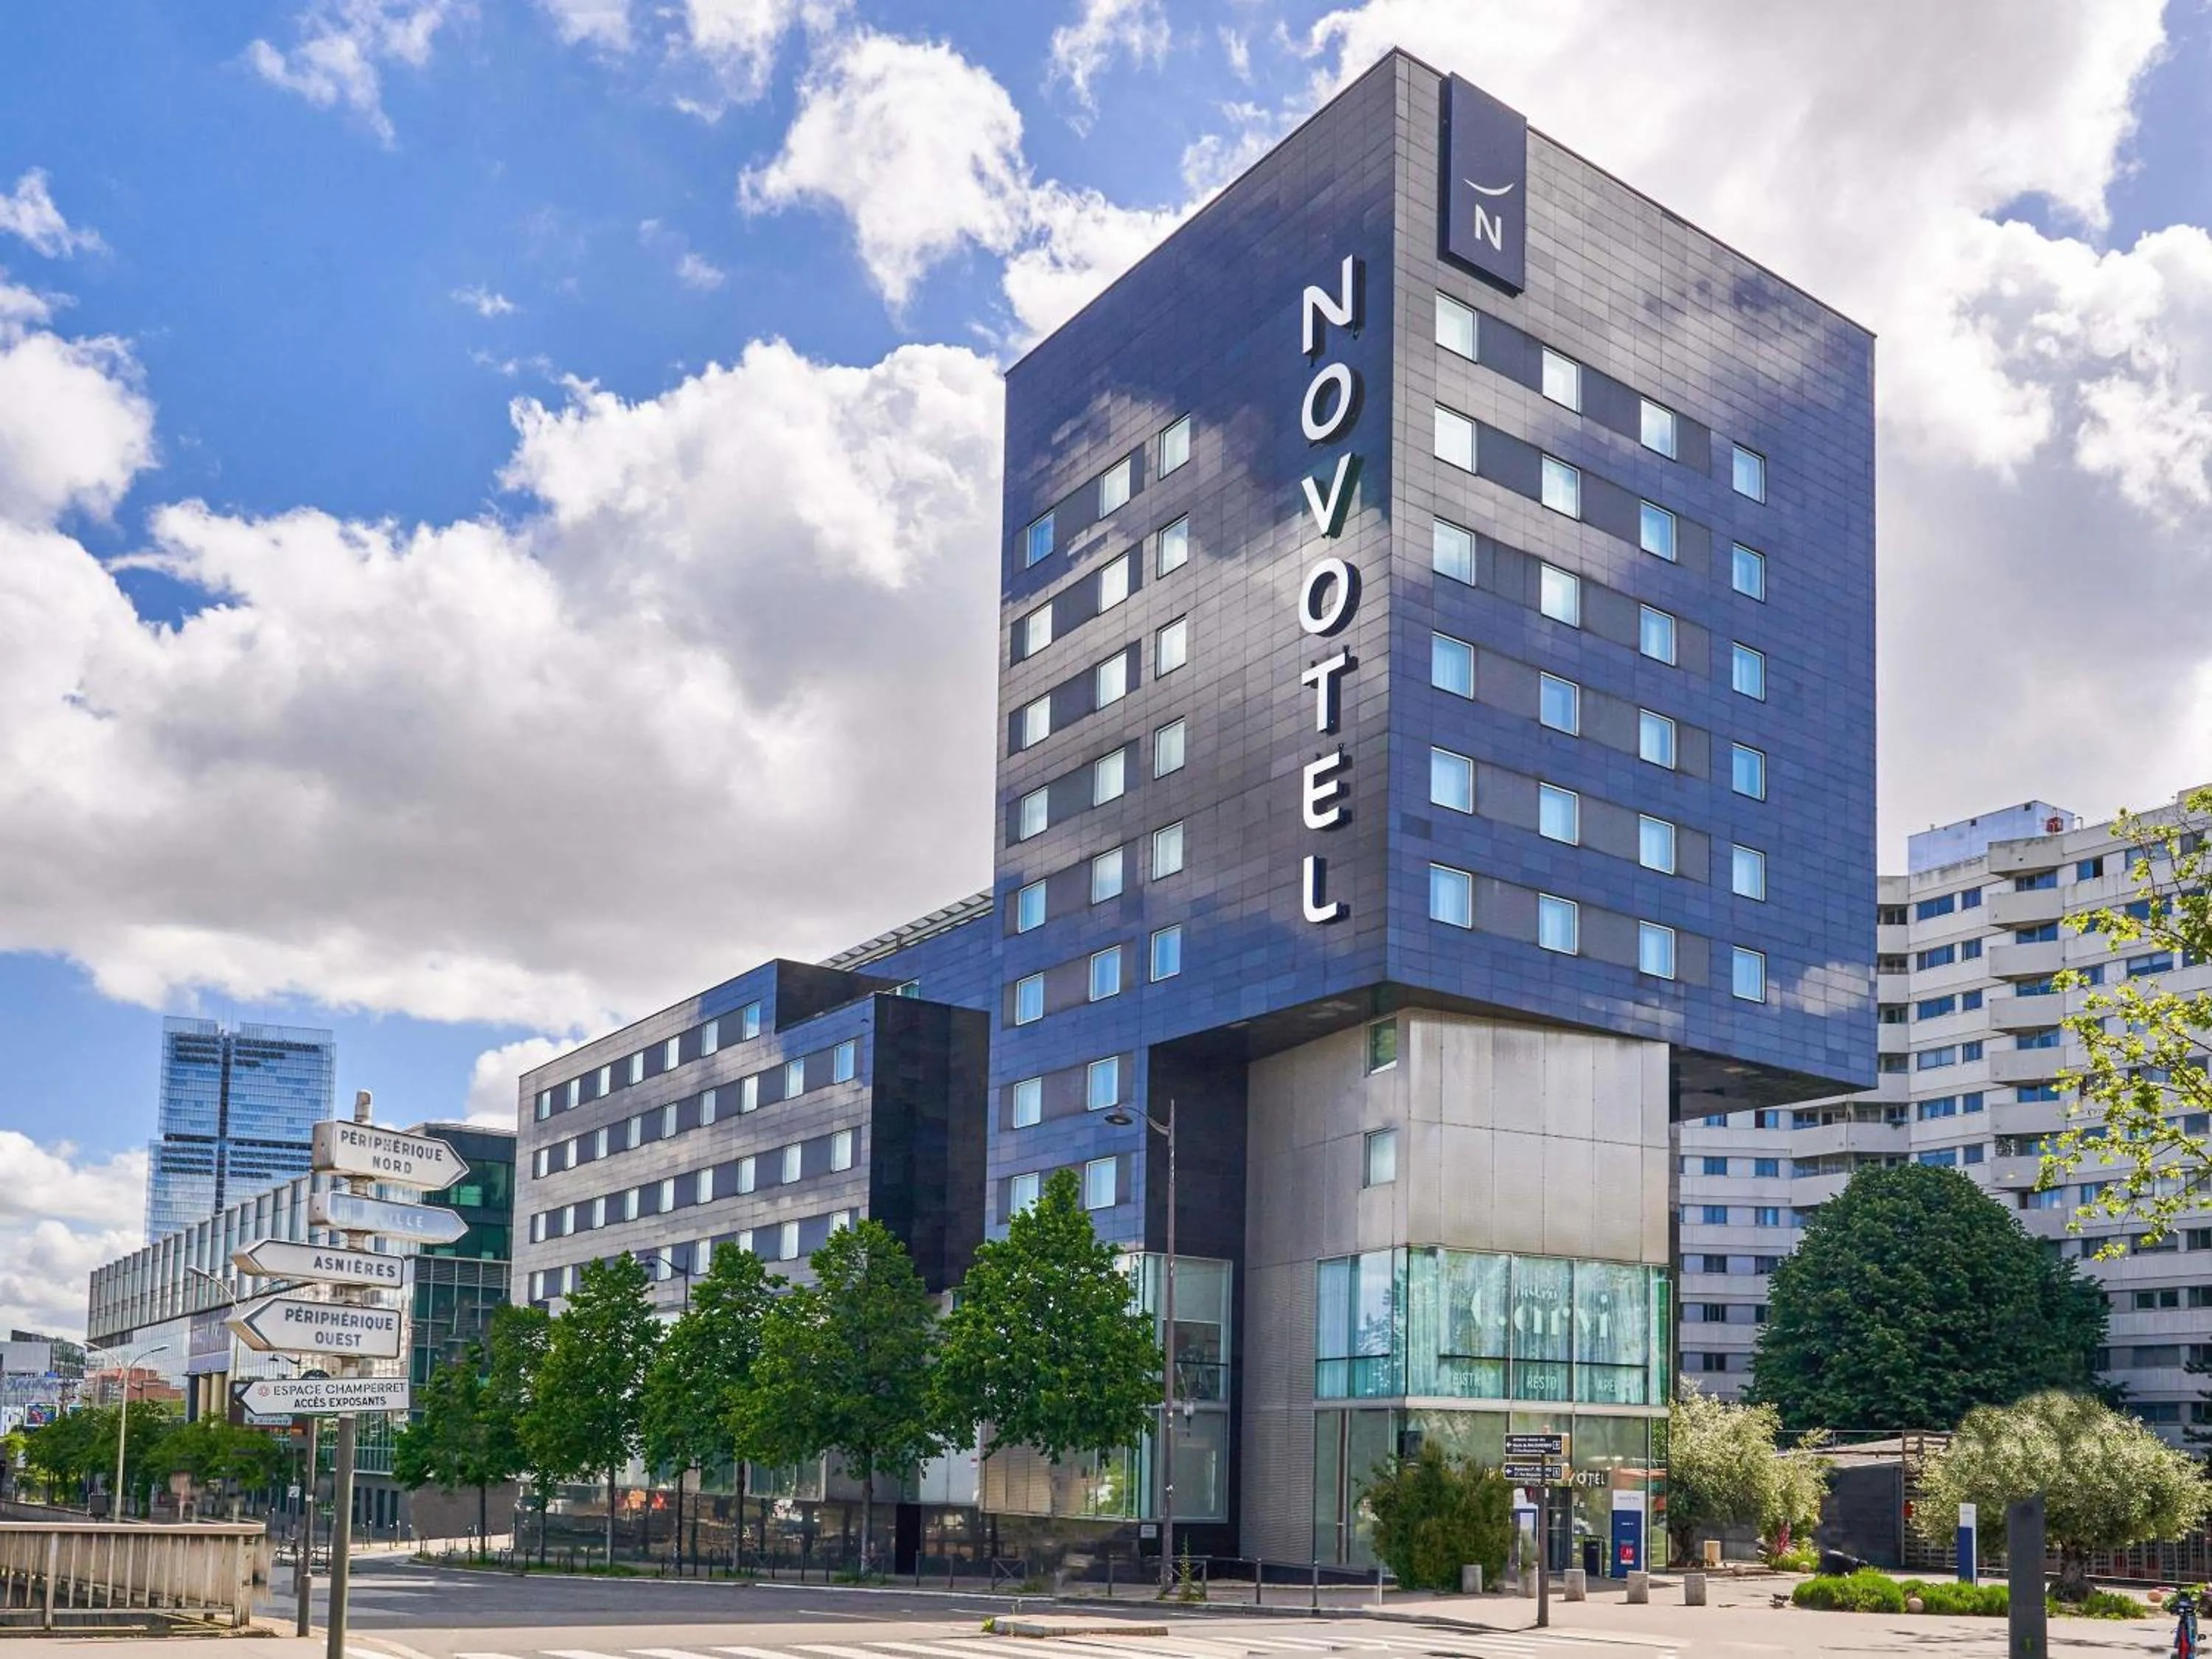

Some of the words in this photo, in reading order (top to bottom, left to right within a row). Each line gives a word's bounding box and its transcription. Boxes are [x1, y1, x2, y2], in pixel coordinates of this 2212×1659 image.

[1475, 203, 1502, 252] N
[1298, 253, 1354, 923] NOVOTEL
[341, 1129, 444, 1162] PÉRIPHÉRIQUE
[372, 1155, 412, 1175] NORD
[313, 1256, 396, 1278] ASNIÈRES
[284, 1306, 394, 1331] PÉRIPHÉRIQUE
[314, 1331, 362, 1347] OUEST
[273, 1383, 321, 1396] ESPACE
[325, 1382, 406, 1395] CHAMPERRET
[1526, 1374, 1557, 1390] RESTO
[293, 1395, 326, 1408] ACCÈS
[330, 1396, 387, 1408] EXPOSANTS
